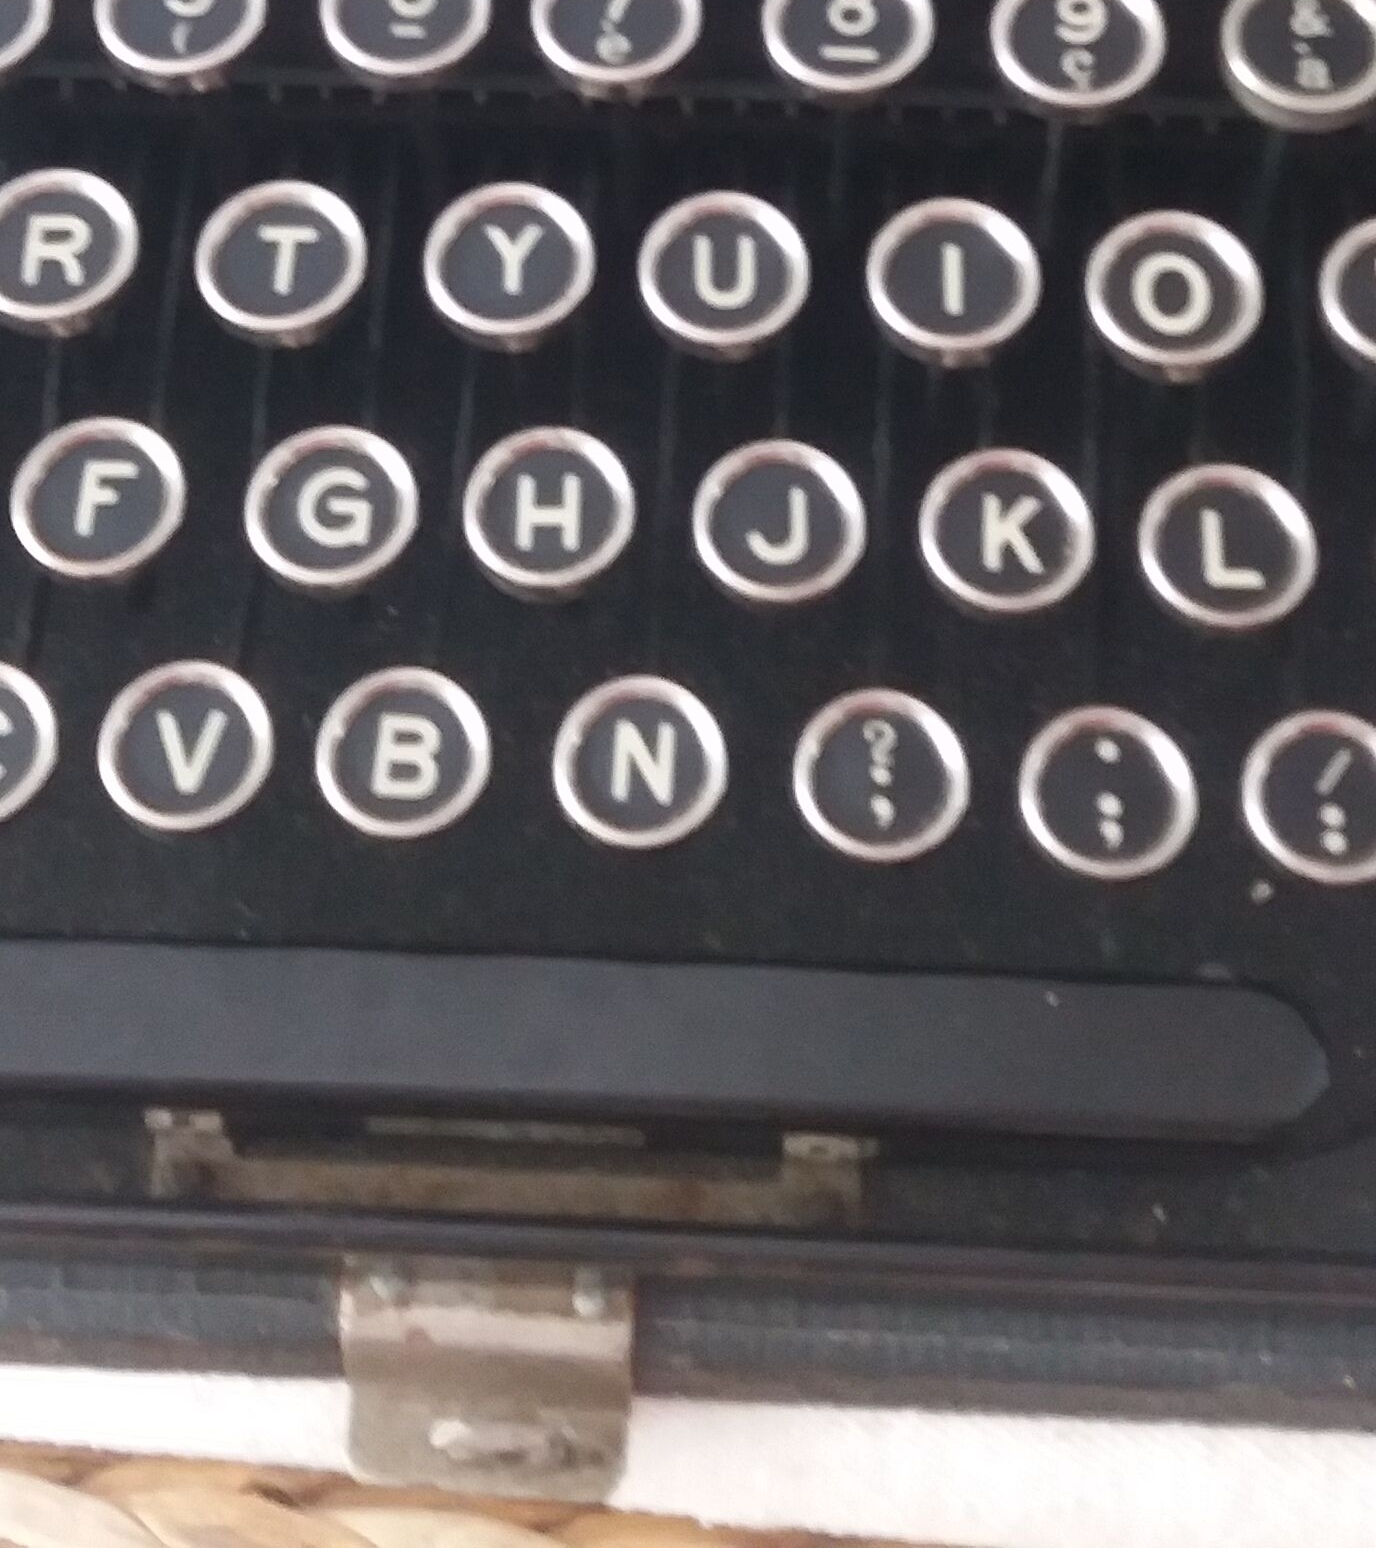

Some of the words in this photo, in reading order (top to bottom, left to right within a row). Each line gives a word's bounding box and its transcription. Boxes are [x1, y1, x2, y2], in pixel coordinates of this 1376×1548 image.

[22, 215, 90, 285] R
[260, 226, 318, 294] T
[486, 225, 542, 294] Y
[694, 236, 755, 308] U
[943, 244, 963, 314] I
[1133, 253, 1211, 334] O
[75, 461, 138, 536] F
[297, 467, 371, 547] G
[516, 475, 580, 550] H
[747, 488, 807, 564] J
[982, 495, 1043, 573] K
[1202, 510, 1264, 588] L
[158, 710, 226, 792] V
[372, 714, 440, 798] B
[612, 721, 675, 803] N
